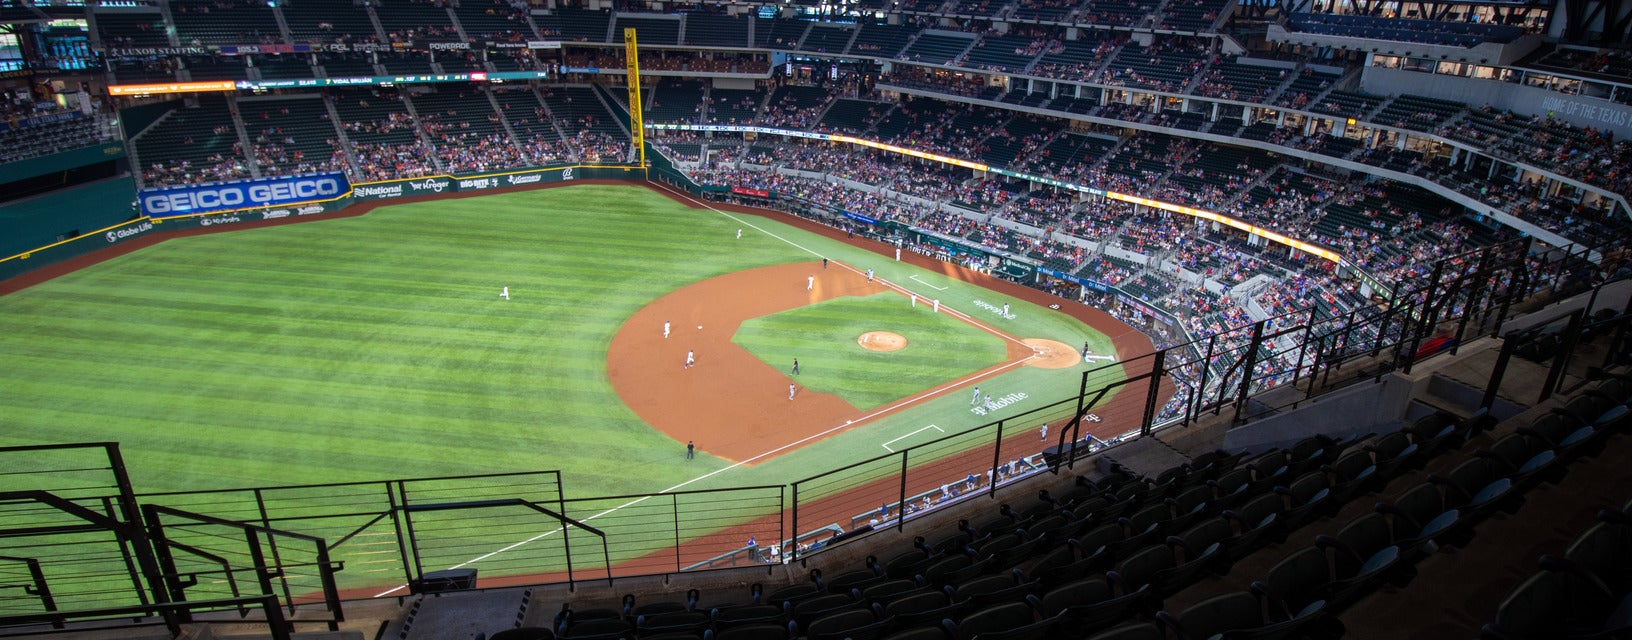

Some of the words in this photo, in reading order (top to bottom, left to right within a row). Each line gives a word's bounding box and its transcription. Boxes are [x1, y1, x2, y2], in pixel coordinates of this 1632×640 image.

[122, 47, 156, 55] LUXOR
[159, 46, 205, 55] STAFFING
[1542, 96, 1566, 113] HOME
[1566, 101, 1580, 115] OF
[1580, 104, 1597, 120] THE
[1597, 107, 1627, 127] TEXAS
[365, 184, 402, 196] National
[422, 178, 449, 193] Kroger
[145, 187, 244, 214] GEICO
[249, 178, 339, 202] GEICO
[117, 227, 139, 239] Globe
[139, 222, 153, 233] Life
